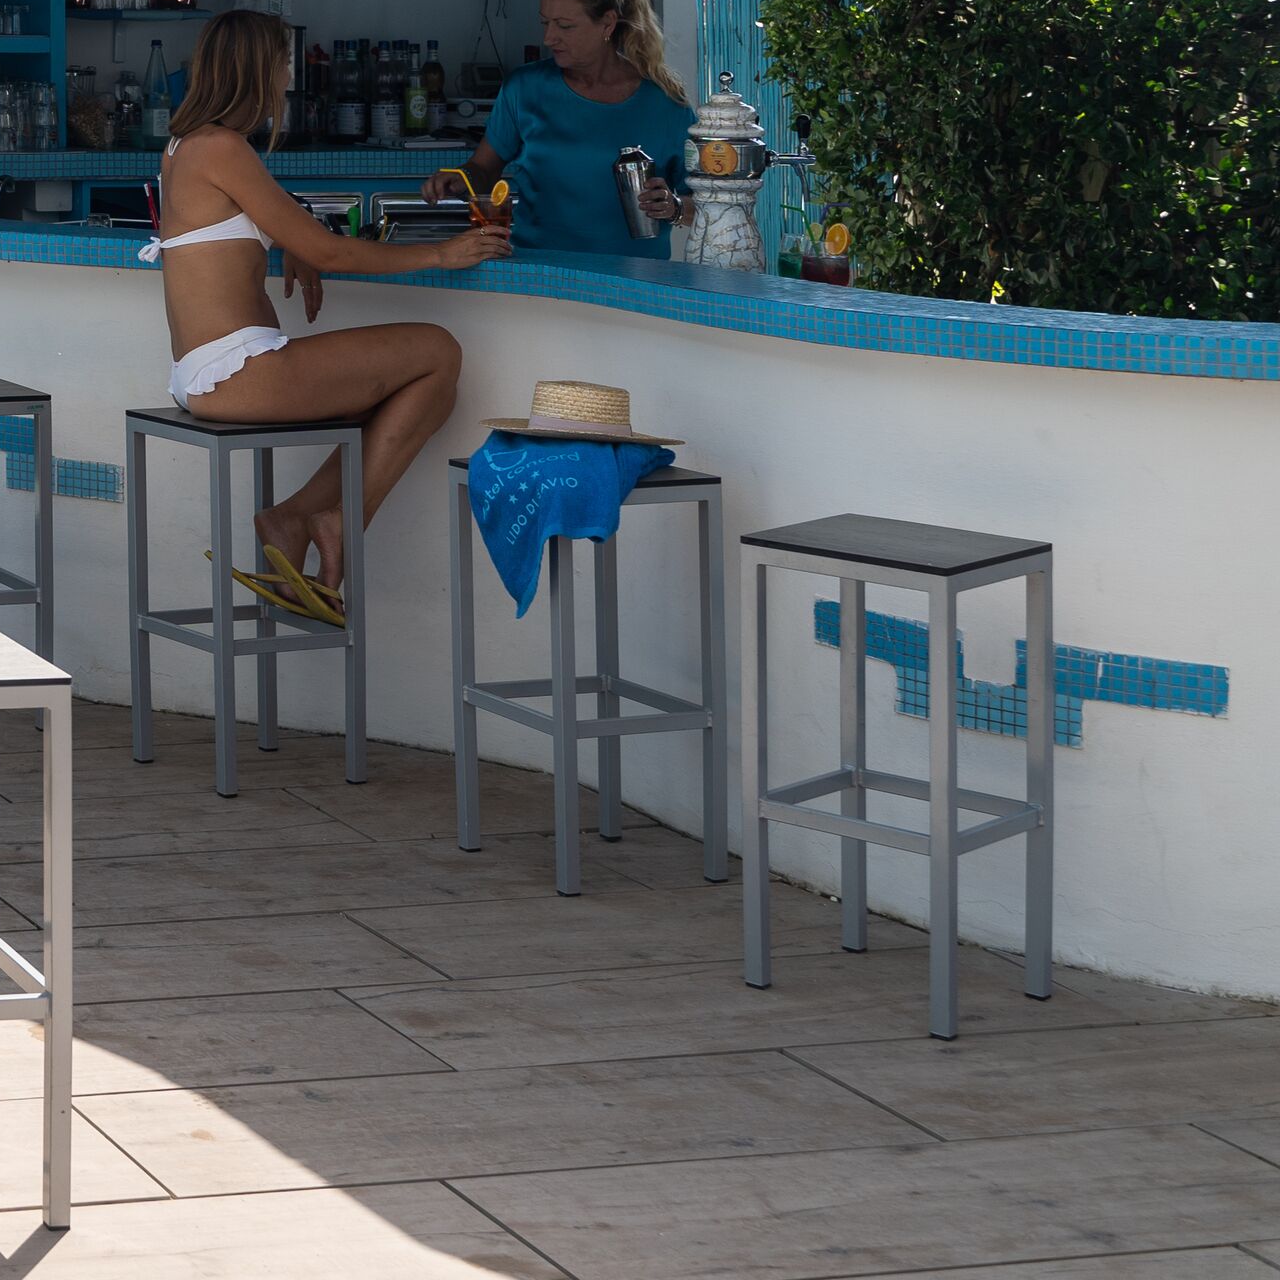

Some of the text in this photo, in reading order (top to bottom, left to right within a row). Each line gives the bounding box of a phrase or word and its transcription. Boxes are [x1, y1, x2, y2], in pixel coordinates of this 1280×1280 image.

[713, 159, 724, 173] 3
[507, 451, 580, 480] concord
[506, 514, 528, 545] LIDO
[526, 498, 539, 515] DI
